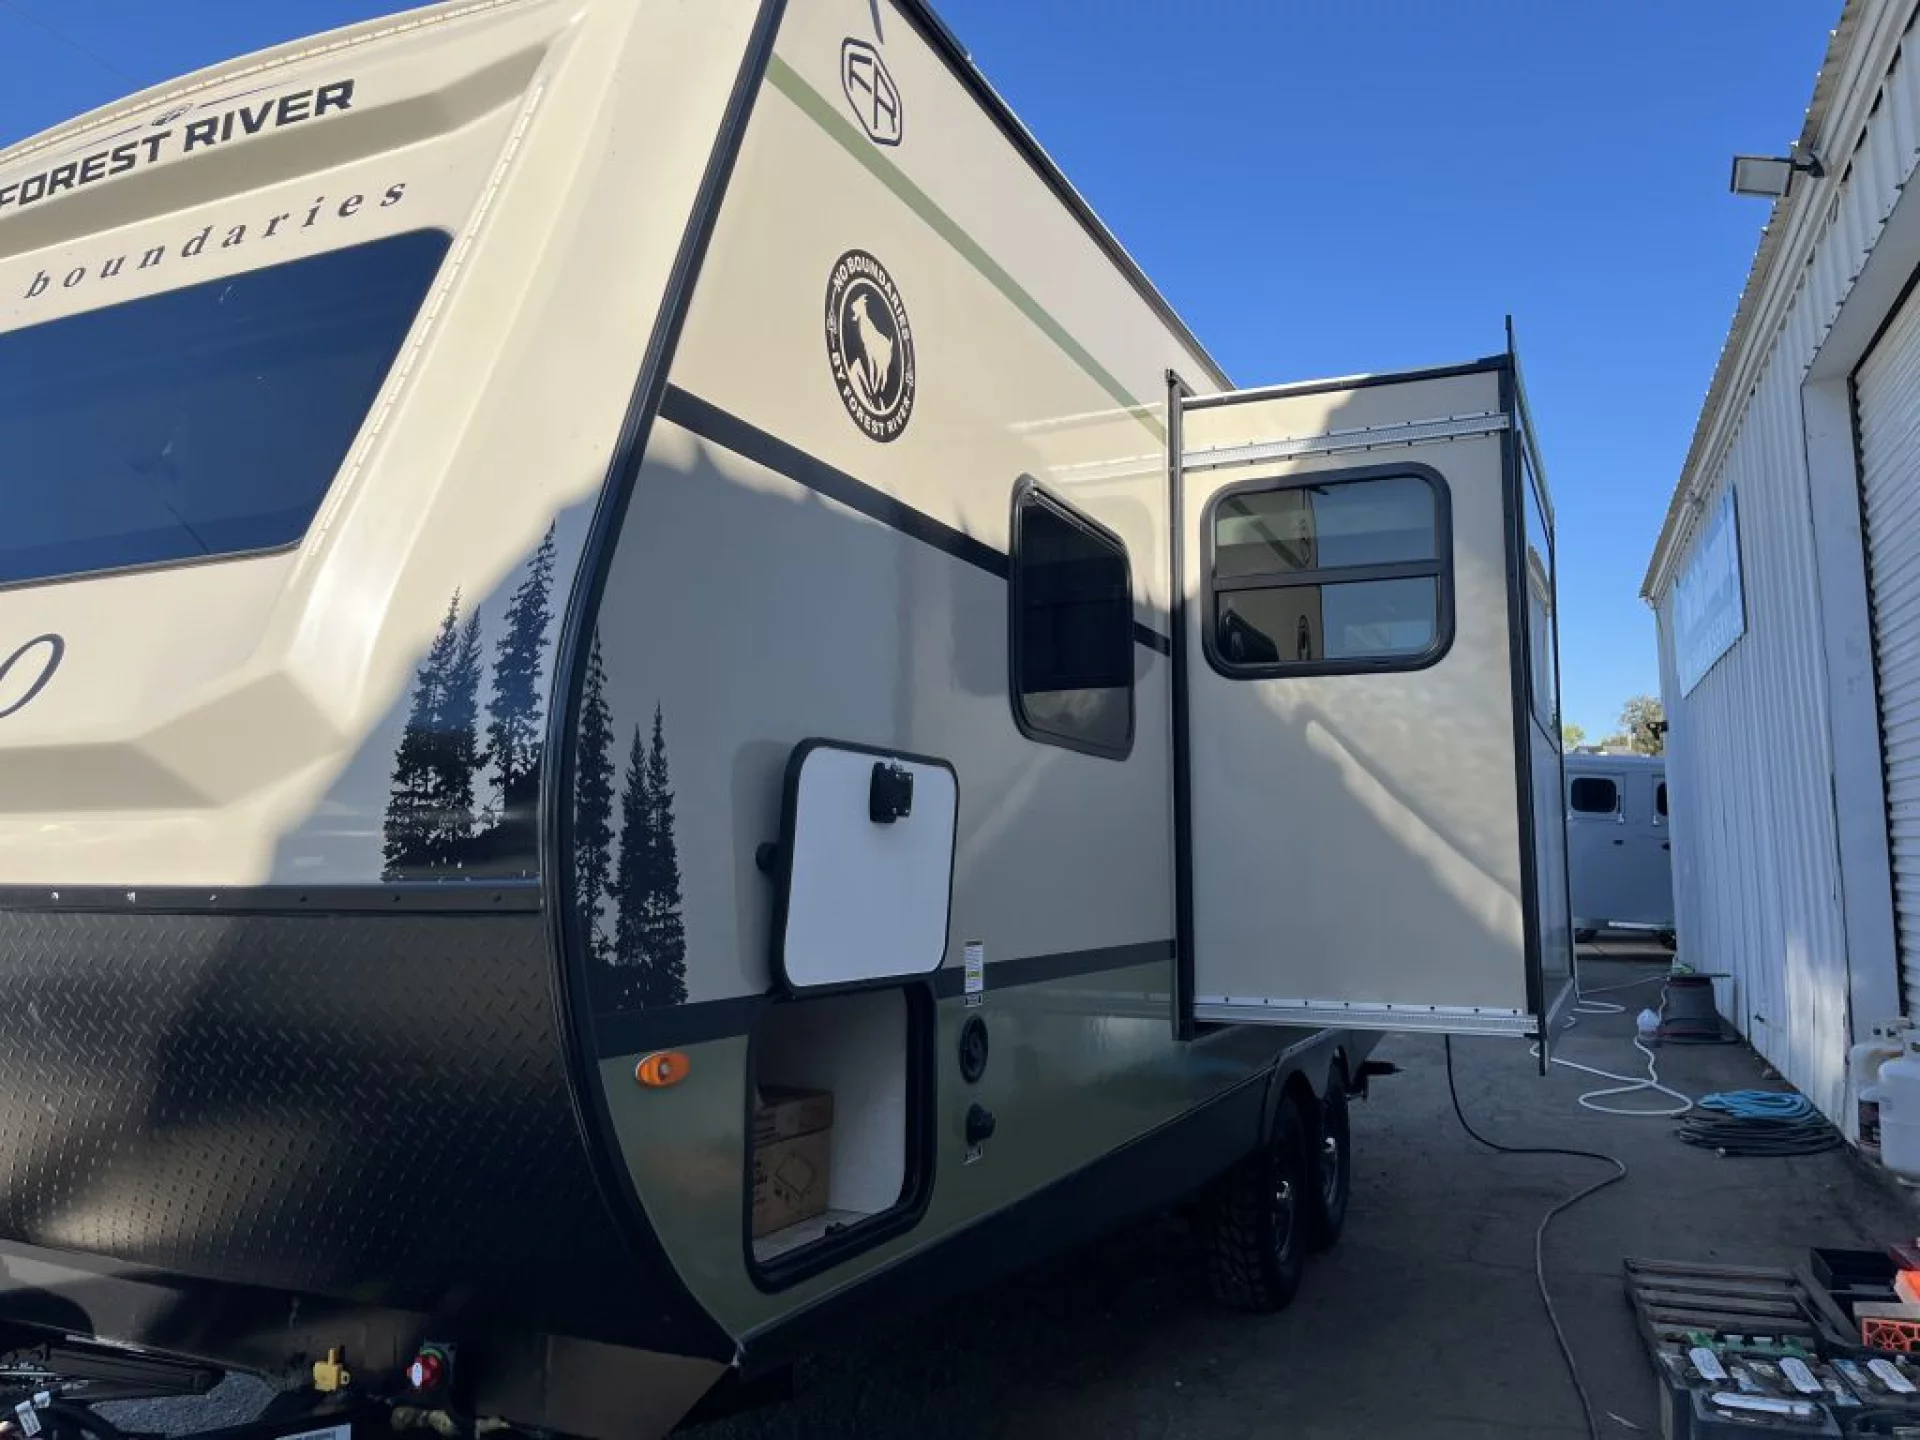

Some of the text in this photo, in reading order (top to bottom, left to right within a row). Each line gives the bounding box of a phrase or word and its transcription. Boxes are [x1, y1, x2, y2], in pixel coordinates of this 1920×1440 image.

[0, 79, 355, 209] FOREST RIVER
[23, 181, 407, 299] boundaries
